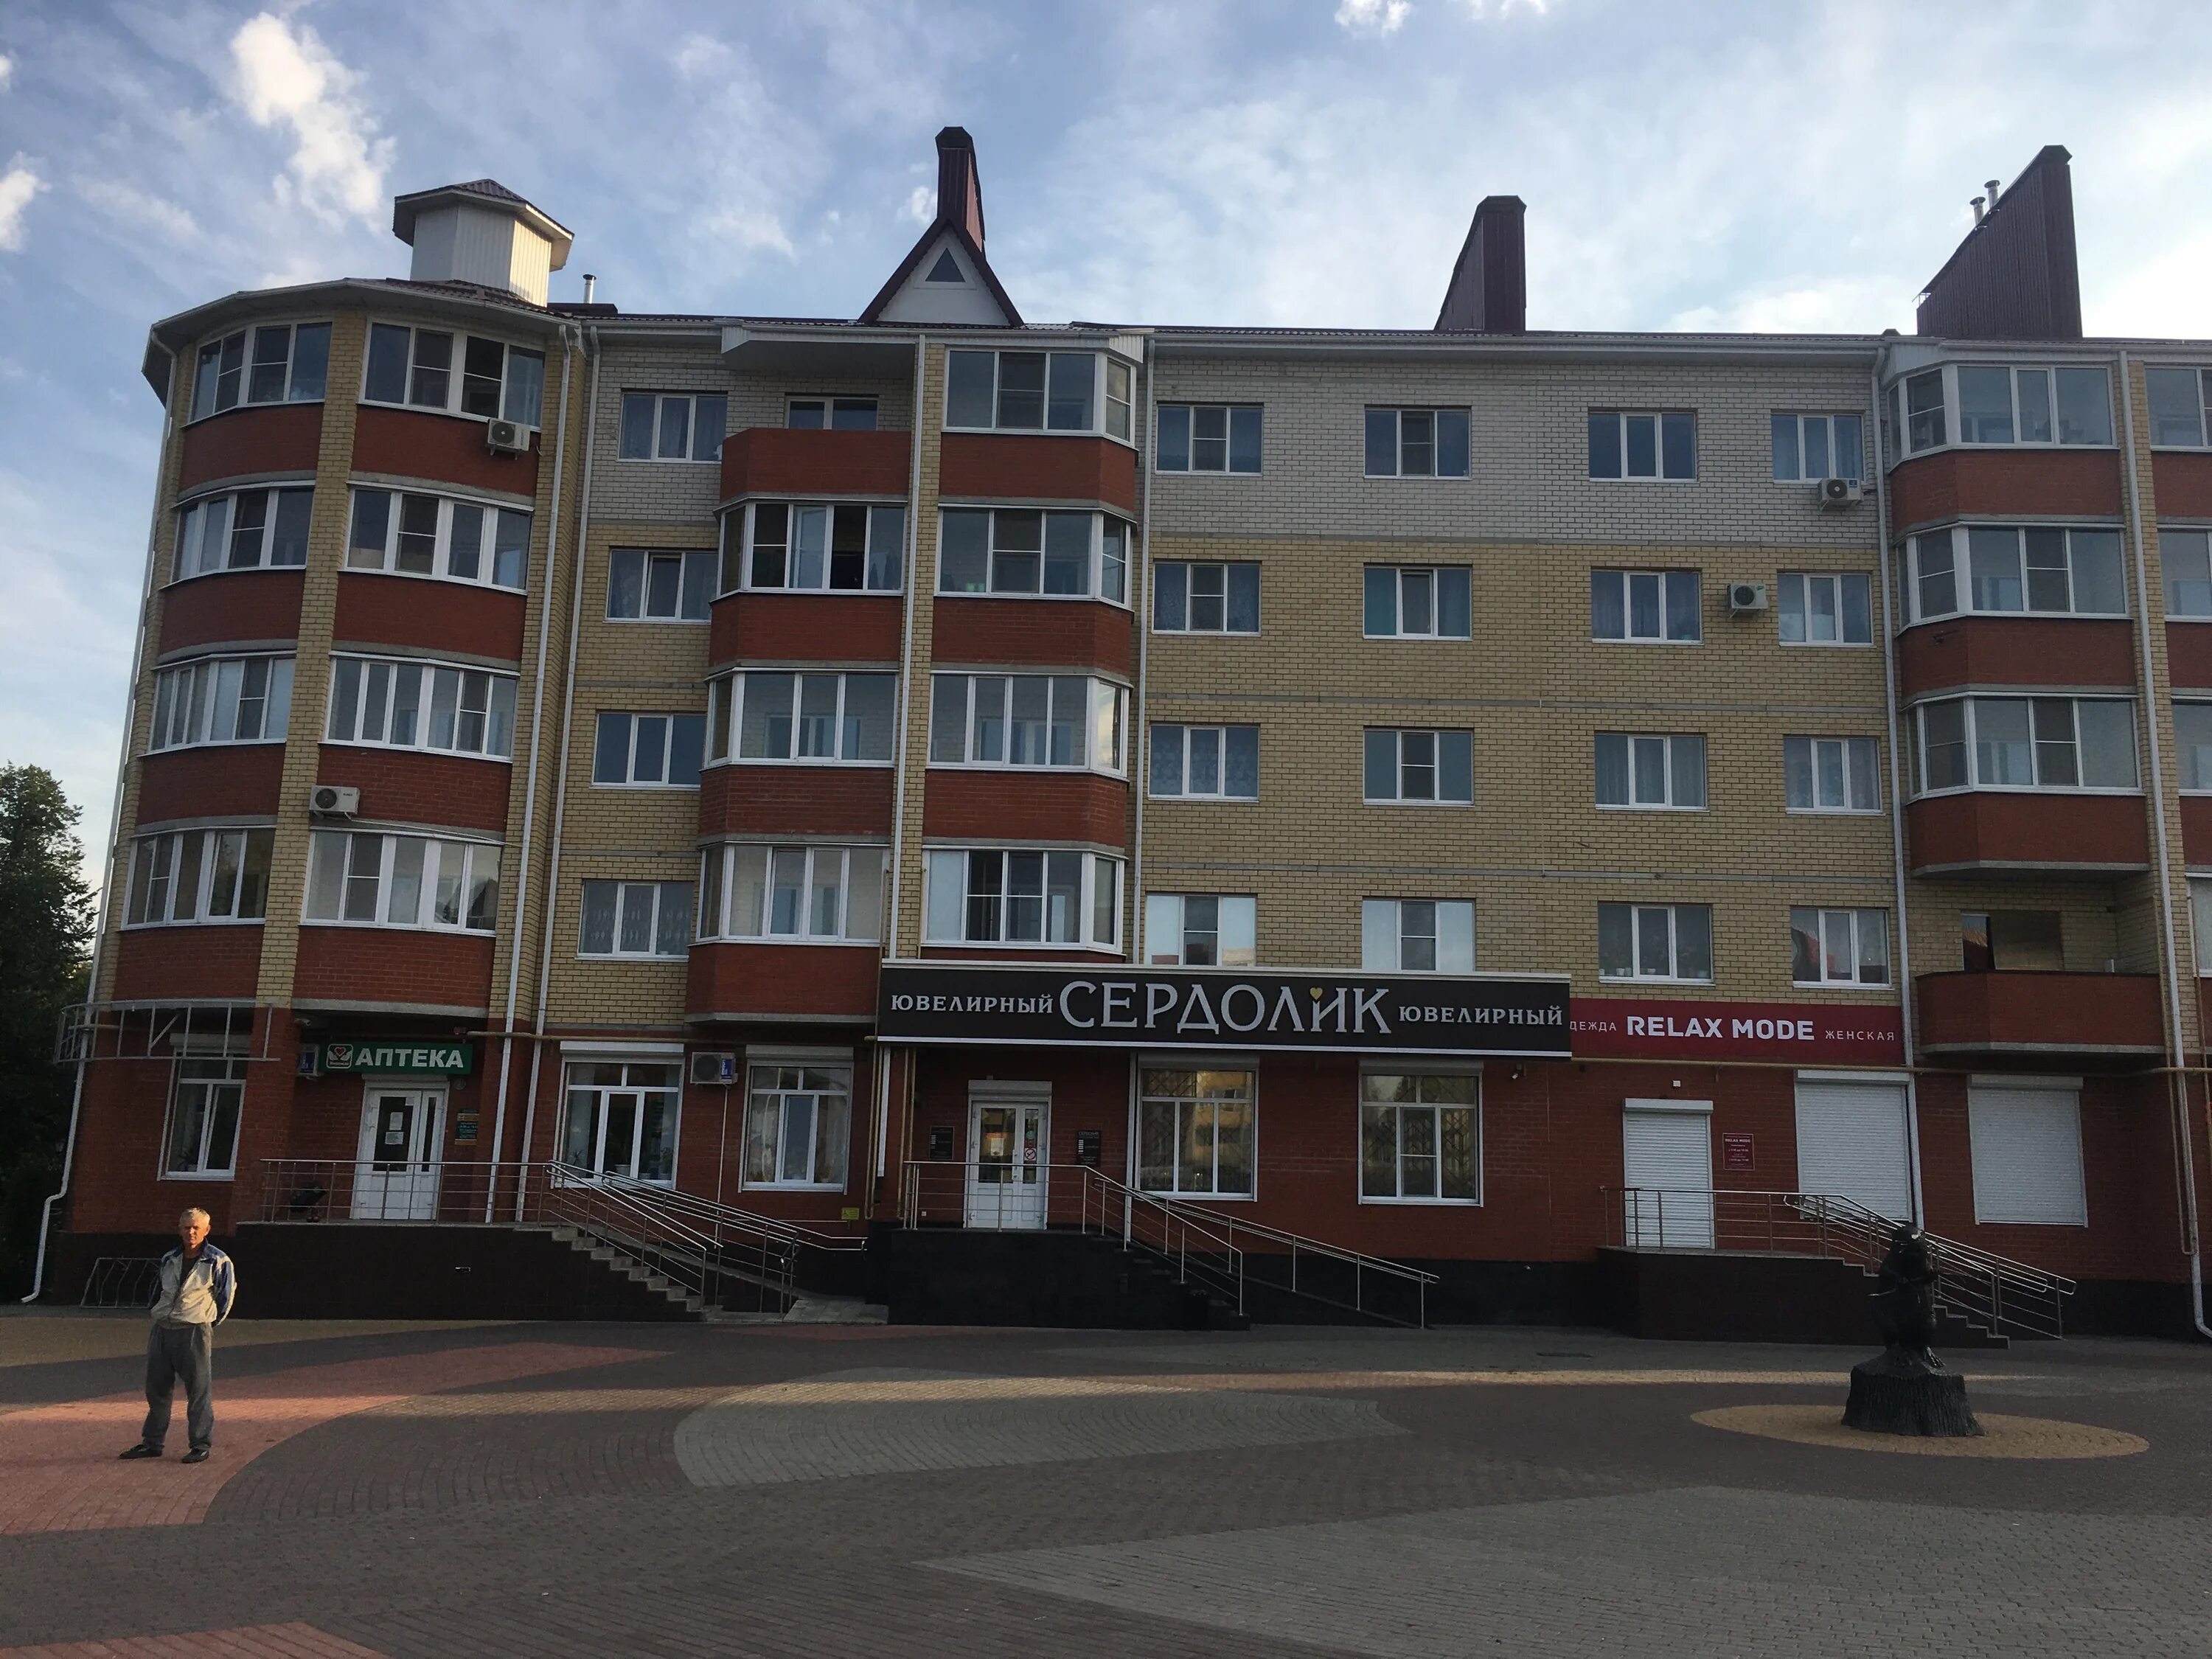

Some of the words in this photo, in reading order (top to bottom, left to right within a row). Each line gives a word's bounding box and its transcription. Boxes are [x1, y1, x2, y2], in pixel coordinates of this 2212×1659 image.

[891, 993, 1054, 1014] ЮВЕЛИРНЫЙ
[1059, 980, 1392, 1035] СЕРДОЛИК
[1399, 1004, 1562, 1026] ЮВЕЛИРНЫЙ
[1570, 1020, 1617, 1032] ДЕЖДА
[1627, 1016, 1723, 1038] RELAX
[1732, 1018, 1815, 1040] MODE
[1825, 1029, 1895, 1041] ЖЕНСКАЯ
[355, 1048, 464, 1068] АПТЕКА
